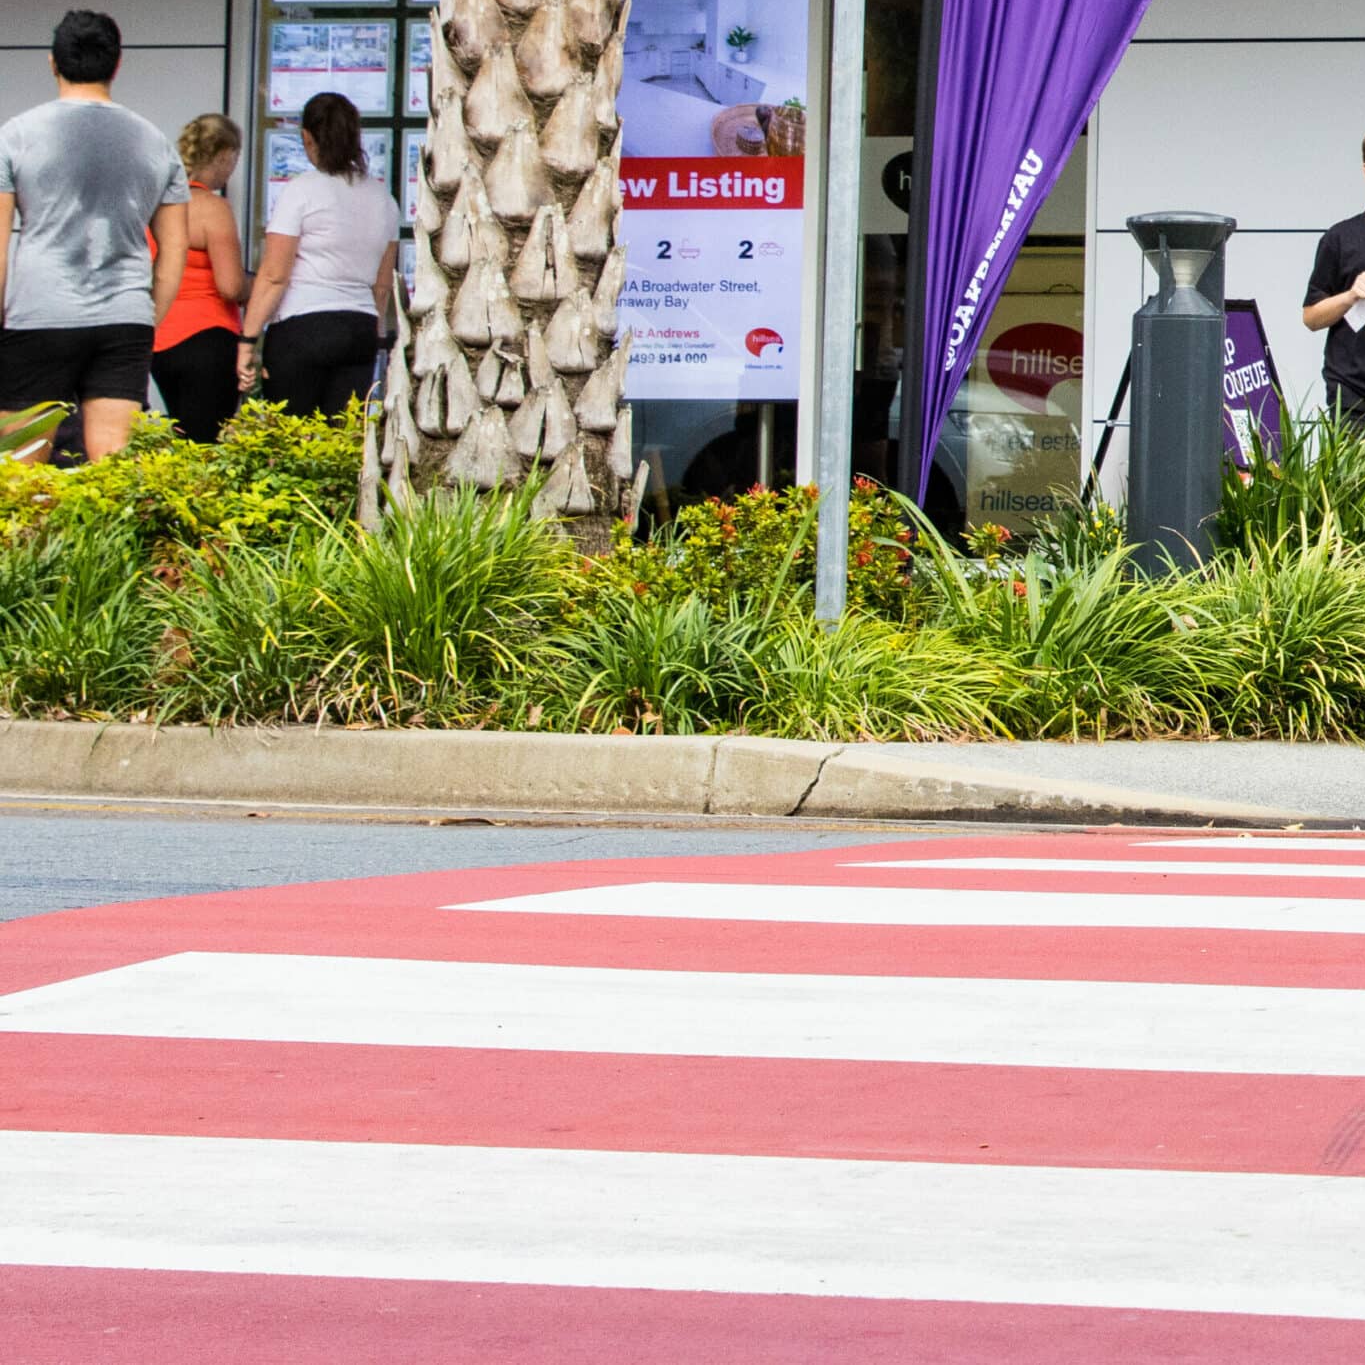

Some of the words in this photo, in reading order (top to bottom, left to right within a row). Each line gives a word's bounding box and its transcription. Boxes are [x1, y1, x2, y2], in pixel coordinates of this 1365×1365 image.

[619, 179, 657, 198] ew
[668, 172, 785, 204] Listing
[656, 240, 672, 259] 2
[738, 240, 753, 259] 2
[641, 280, 715, 293] Broadwater
[719, 280, 762, 294] Street,
[664, 296, 689, 310] Bay
[647, 328, 700, 339] Andrews
[659, 353, 681, 364] 914
[685, 353, 708, 363] 000
[1224, 360, 1270, 400] QUEUE
